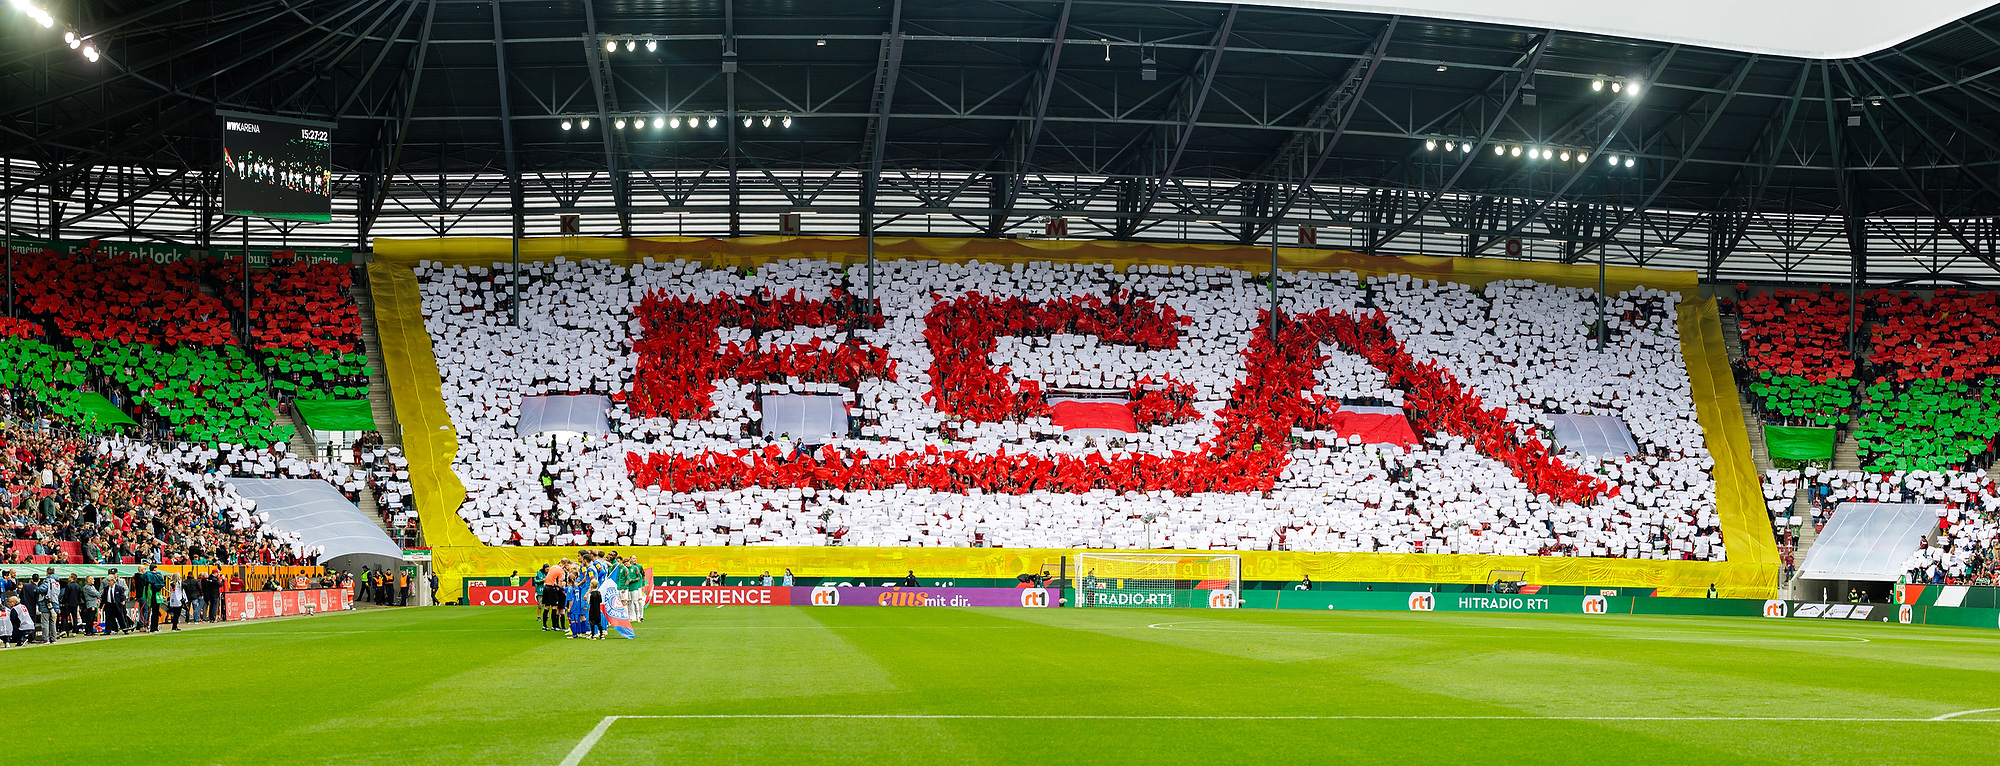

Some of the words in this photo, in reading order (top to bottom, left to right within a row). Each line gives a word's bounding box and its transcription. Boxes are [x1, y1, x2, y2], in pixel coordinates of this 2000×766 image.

[301, 129, 328, 141] 15:27:22
[562, 216, 577, 233] K
[784, 215, 794, 231] L
[1047, 219, 1067, 236] M
[1299, 228, 1316, 245] N
[489, 589, 529, 604] OUR
[653, 589, 771, 604] EXPERIENCE
[815, 590, 836, 605] rt1
[878, 586, 928, 606] eins
[925, 594, 947, 606] mit
[950, 594, 971, 606] dir.
[1025, 591, 1046, 606] rt1
[1075, 593, 1144, 605] HTRADIO
[1149, 593, 1172, 605] RT1
[1212, 593, 1233, 608] rt1
[1412, 595, 1432, 610] rt1
[1458, 597, 1523, 609] HITRADIO
[1527, 598, 1548, 610] RT1
[1585, 598, 1604, 613] rt1
[1767, 602, 1784, 617] rt1
[1900, 607, 1911, 622] rt1
